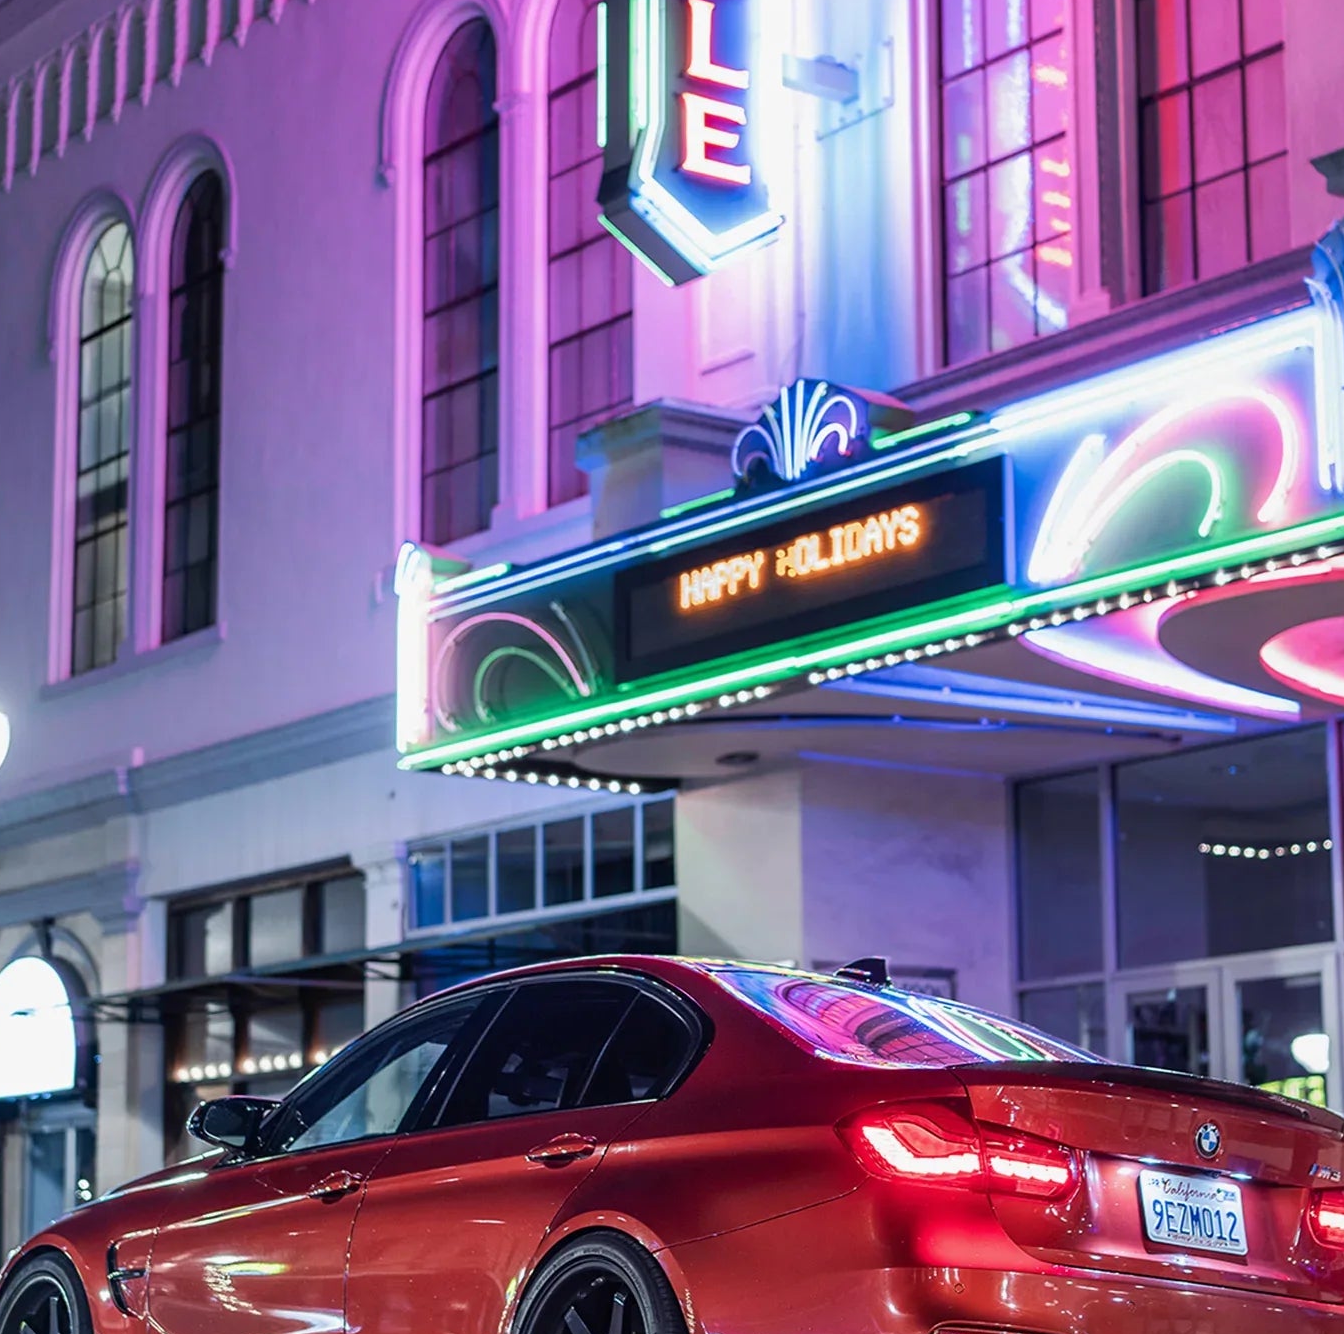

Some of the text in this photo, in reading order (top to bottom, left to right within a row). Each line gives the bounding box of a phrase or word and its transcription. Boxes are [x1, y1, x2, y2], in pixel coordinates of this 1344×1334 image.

[679, 550, 765, 609] HAPPY
[1162, 1178, 1217, 1202] California
[1152, 1199, 1240, 1243] 9EZM012
